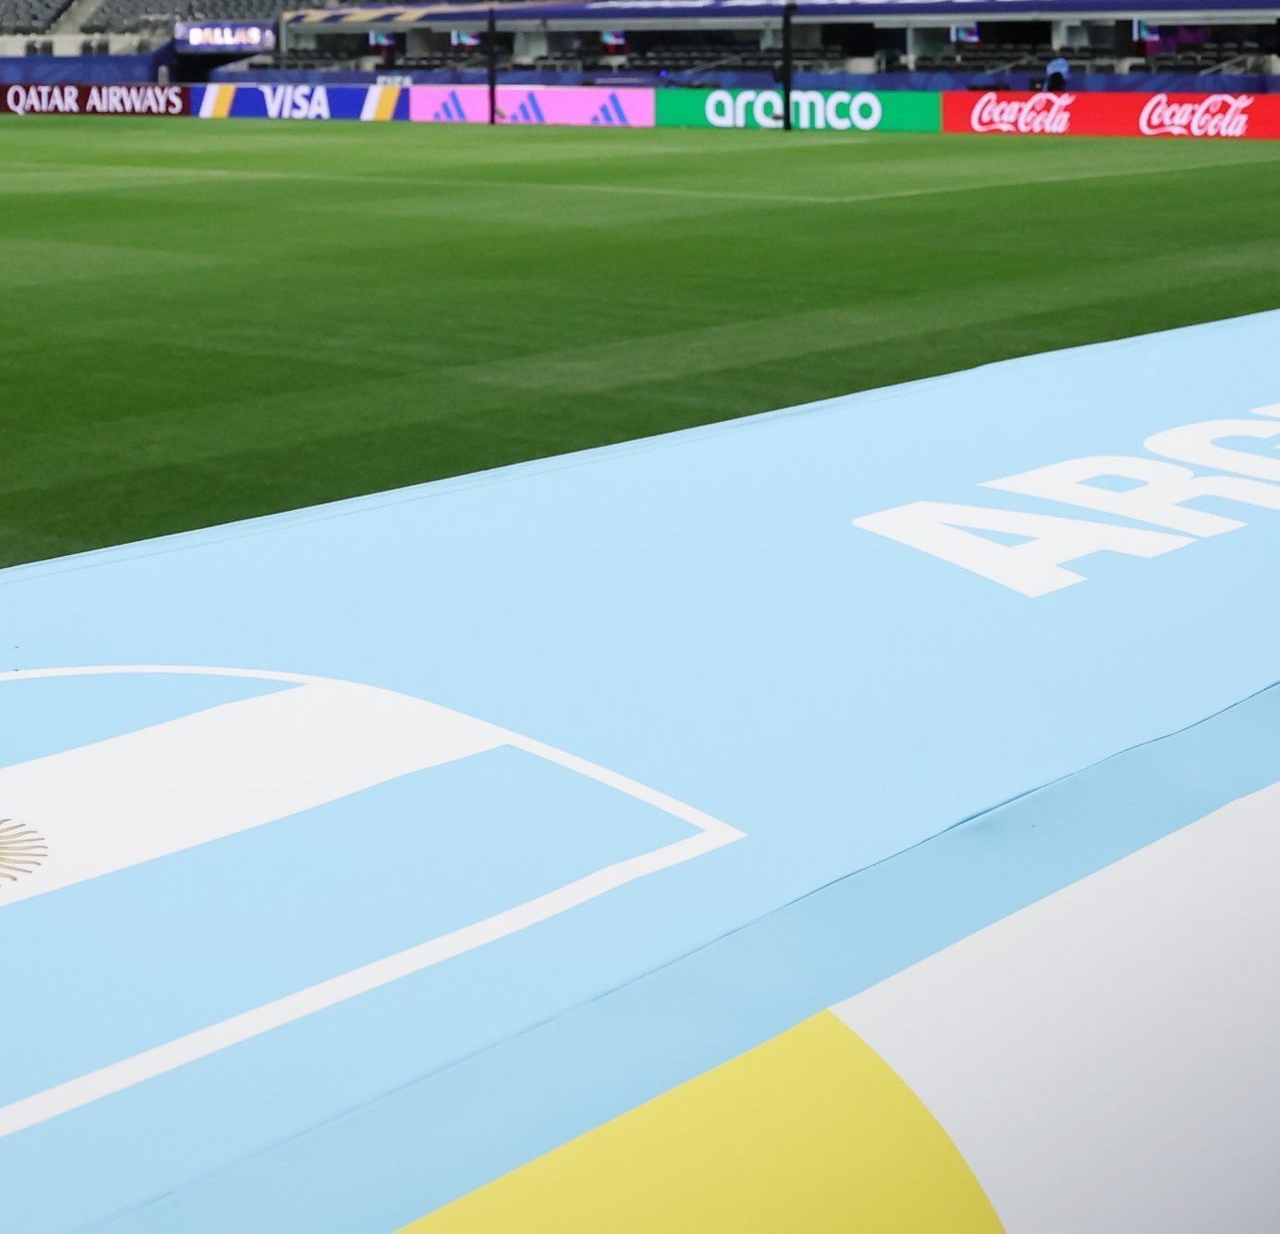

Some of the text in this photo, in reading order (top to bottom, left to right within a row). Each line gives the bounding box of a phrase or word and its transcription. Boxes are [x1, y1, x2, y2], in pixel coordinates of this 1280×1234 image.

[6, 84, 183, 115] QATAR AIRWAYS
[258, 85, 330, 119] VISA
[705, 90, 882, 129] aramco
[971, 92, 1076, 134] Coca-Cola
[1139, 93, 1254, 138] Coca-Cola
